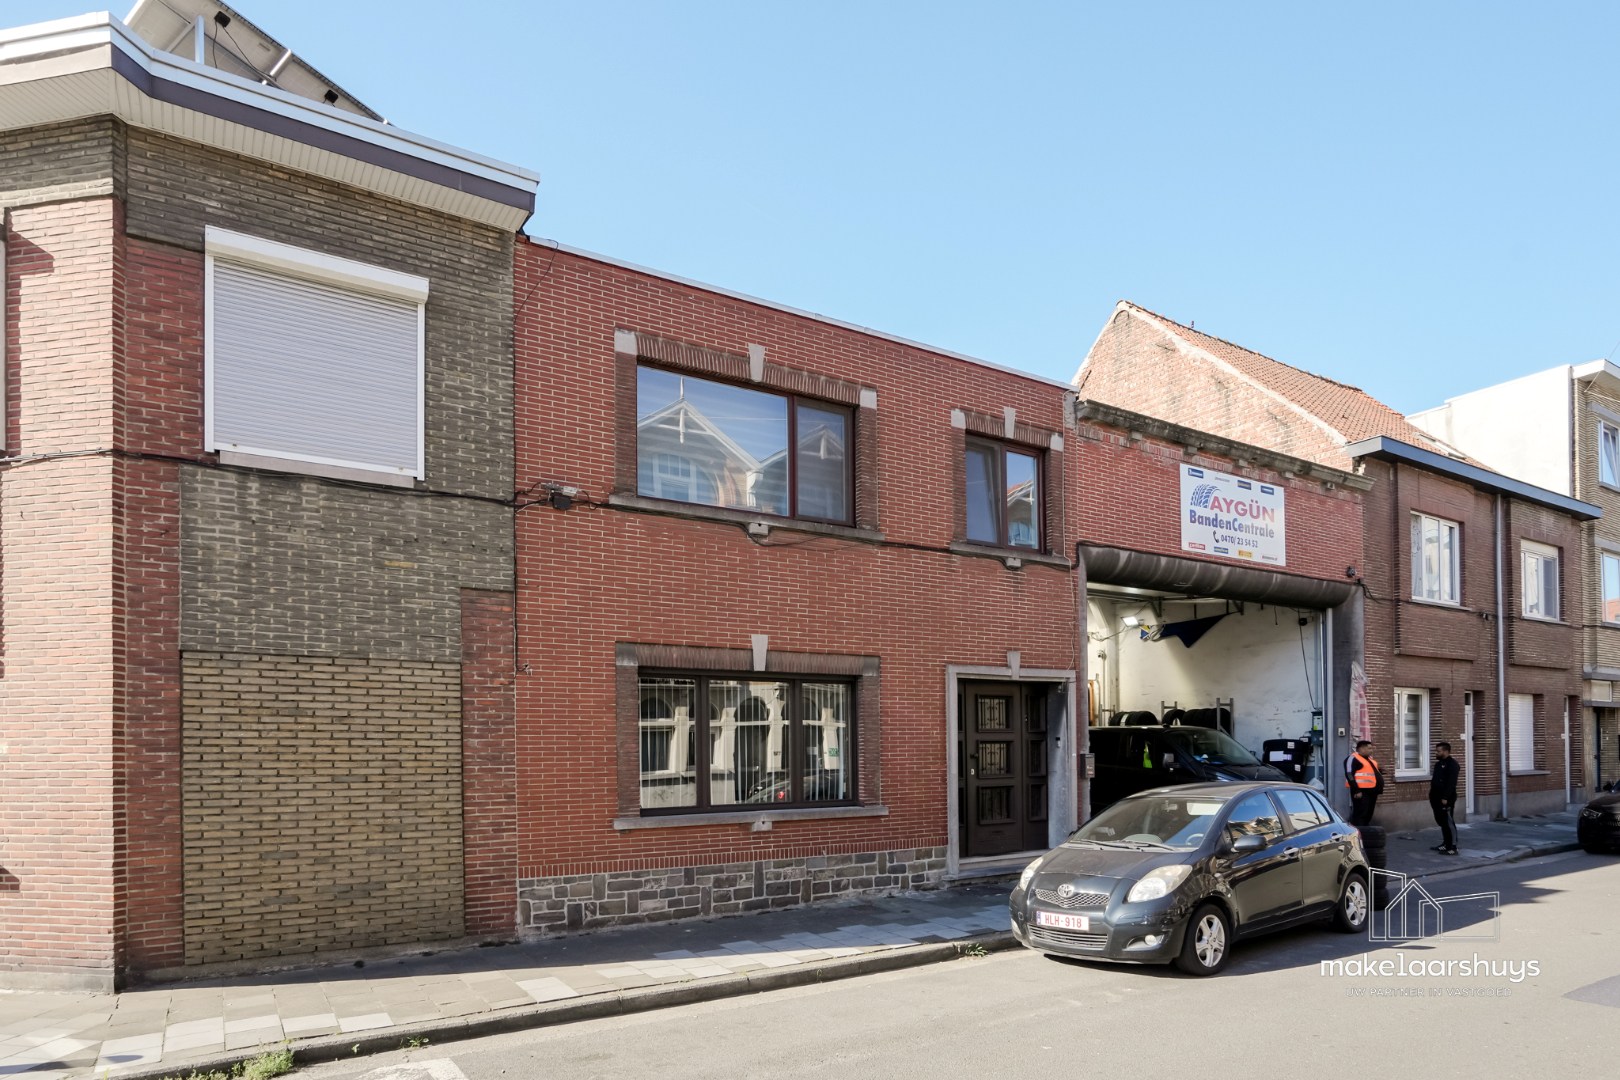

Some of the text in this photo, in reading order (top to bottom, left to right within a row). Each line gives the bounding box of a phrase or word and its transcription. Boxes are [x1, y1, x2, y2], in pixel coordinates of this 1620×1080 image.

[1210, 496, 1274, 523] AYGÜN
[1189, 509, 1274, 538] BandenCentrale
[1237, 537, 1243, 545] 23
[1045, 914, 1081, 928] HLH-918
